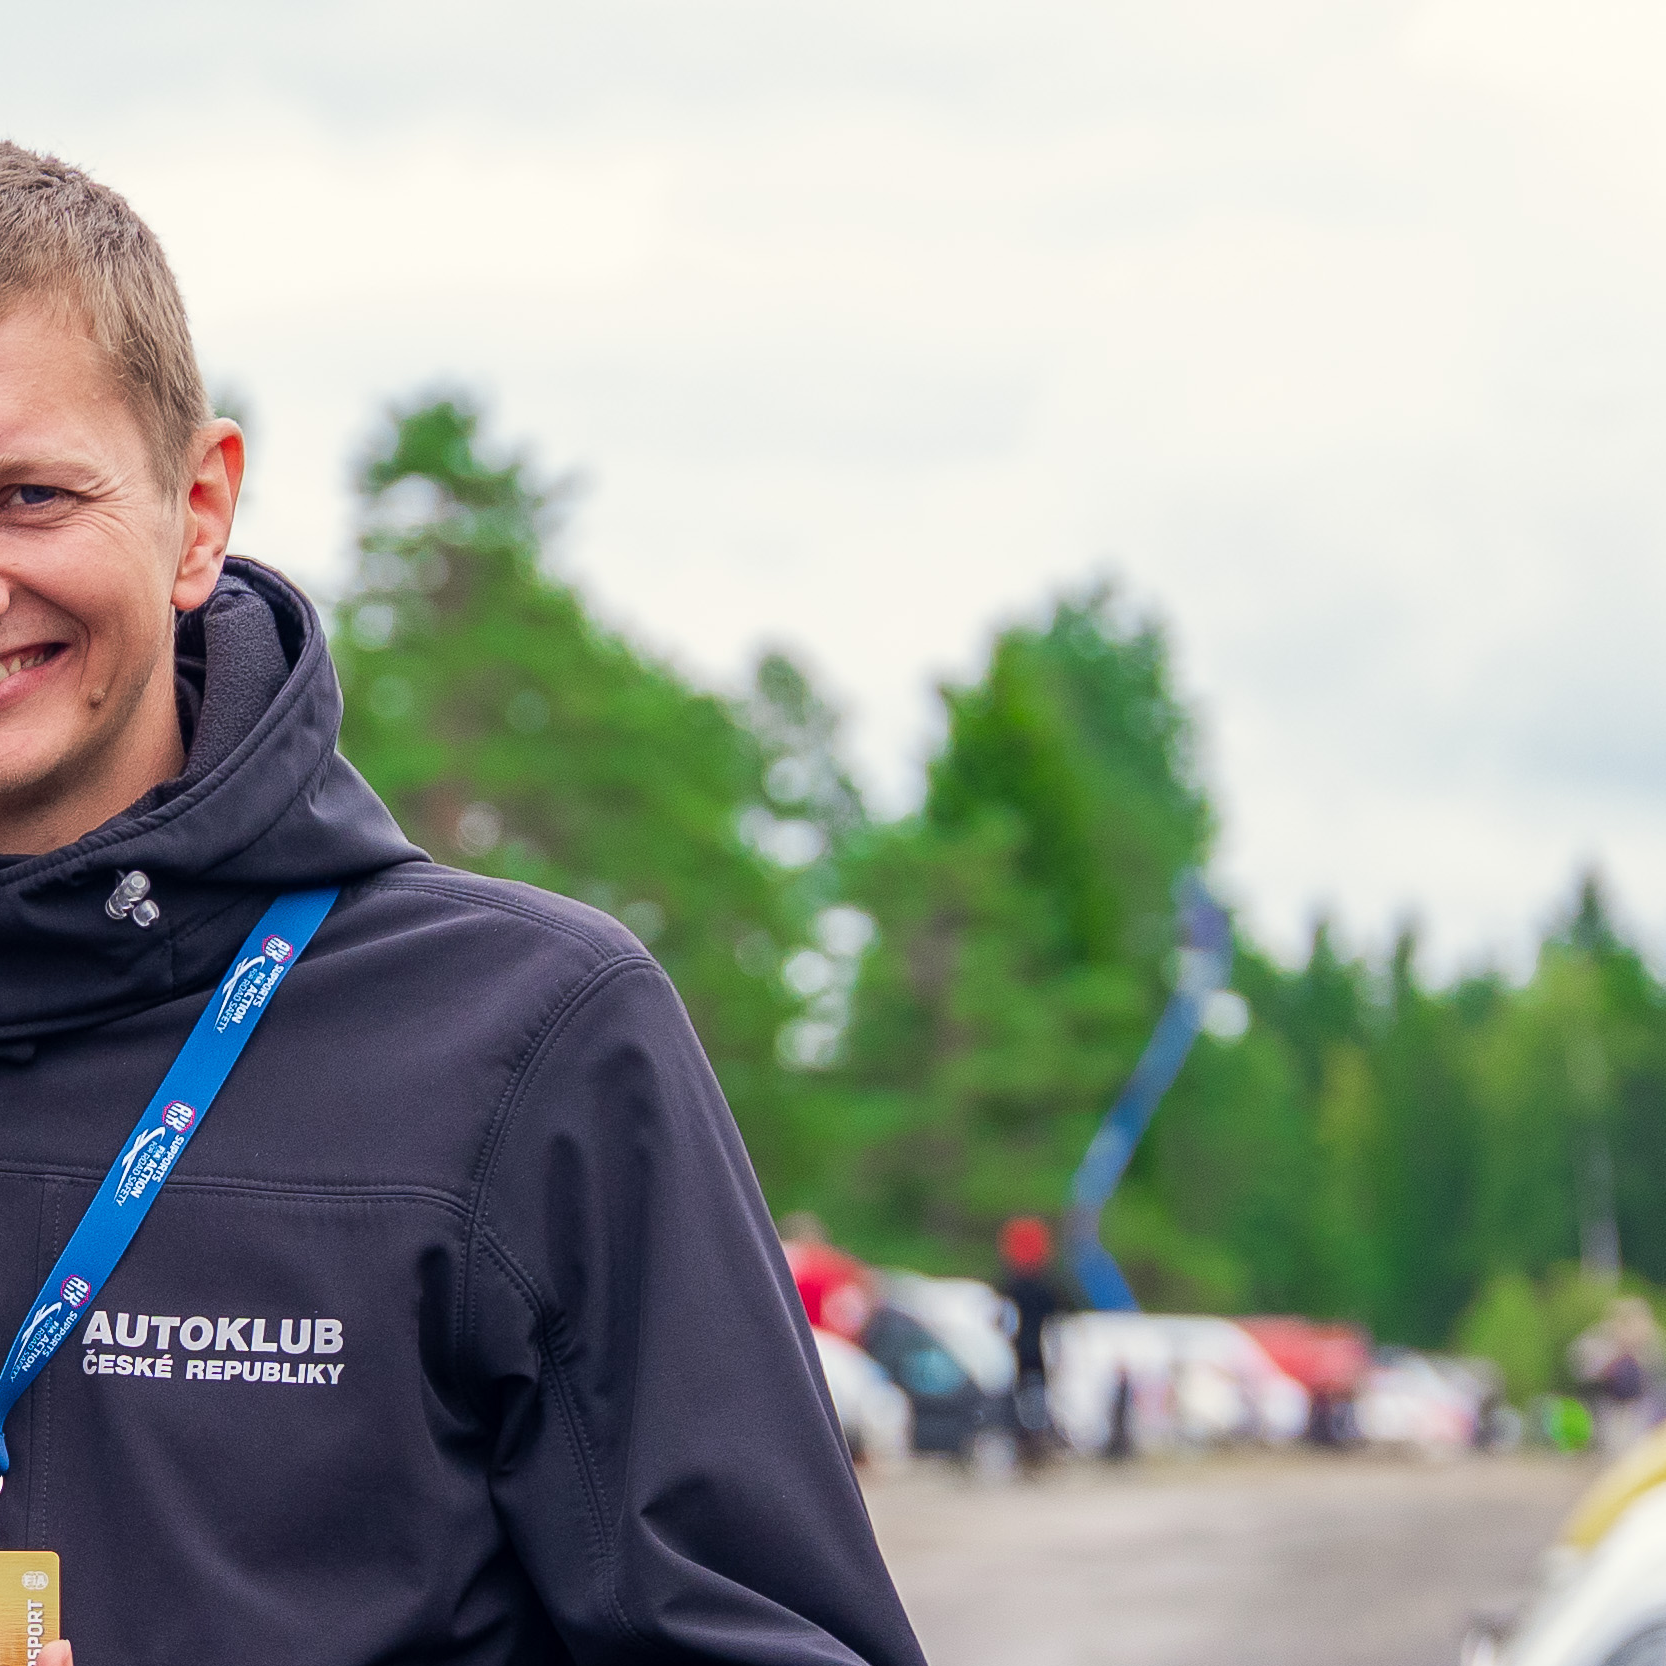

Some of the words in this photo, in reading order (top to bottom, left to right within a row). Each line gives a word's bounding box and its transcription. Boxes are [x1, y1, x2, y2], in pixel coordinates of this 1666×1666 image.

[265, 937, 291, 962] AKK
[233, 979, 250, 1001] ROAD
[253, 964, 284, 1007] SUPPORTS
[254, 971, 266, 985] FIA
[216, 1001, 237, 1033] SAFETY
[232, 983, 257, 1024] ACTION
[166, 1102, 193, 1131] AKK
[132, 1152, 150, 1176] ROAD
[152, 1135, 185, 1183] SUPPORTS
[153, 1145, 166, 1160] FIA
[116, 1175, 136, 1206] SAFETY
[130, 1159, 158, 1198] ACTION
[63, 1276, 89, 1307] AKK
[28, 1327, 45, 1350] ROAD
[43, 1310, 78, 1357] SUPPORTS
[48, 1321, 60, 1334] FIA
[82, 1310, 344, 1354] AUTOKLUB
[10, 1350, 29, 1382] SAFETY
[21, 1334, 49, 1372] ACTION
[83, 1349, 173, 1379] ČESKÉ
[185, 1359, 345, 1384] REPUBLIKY
